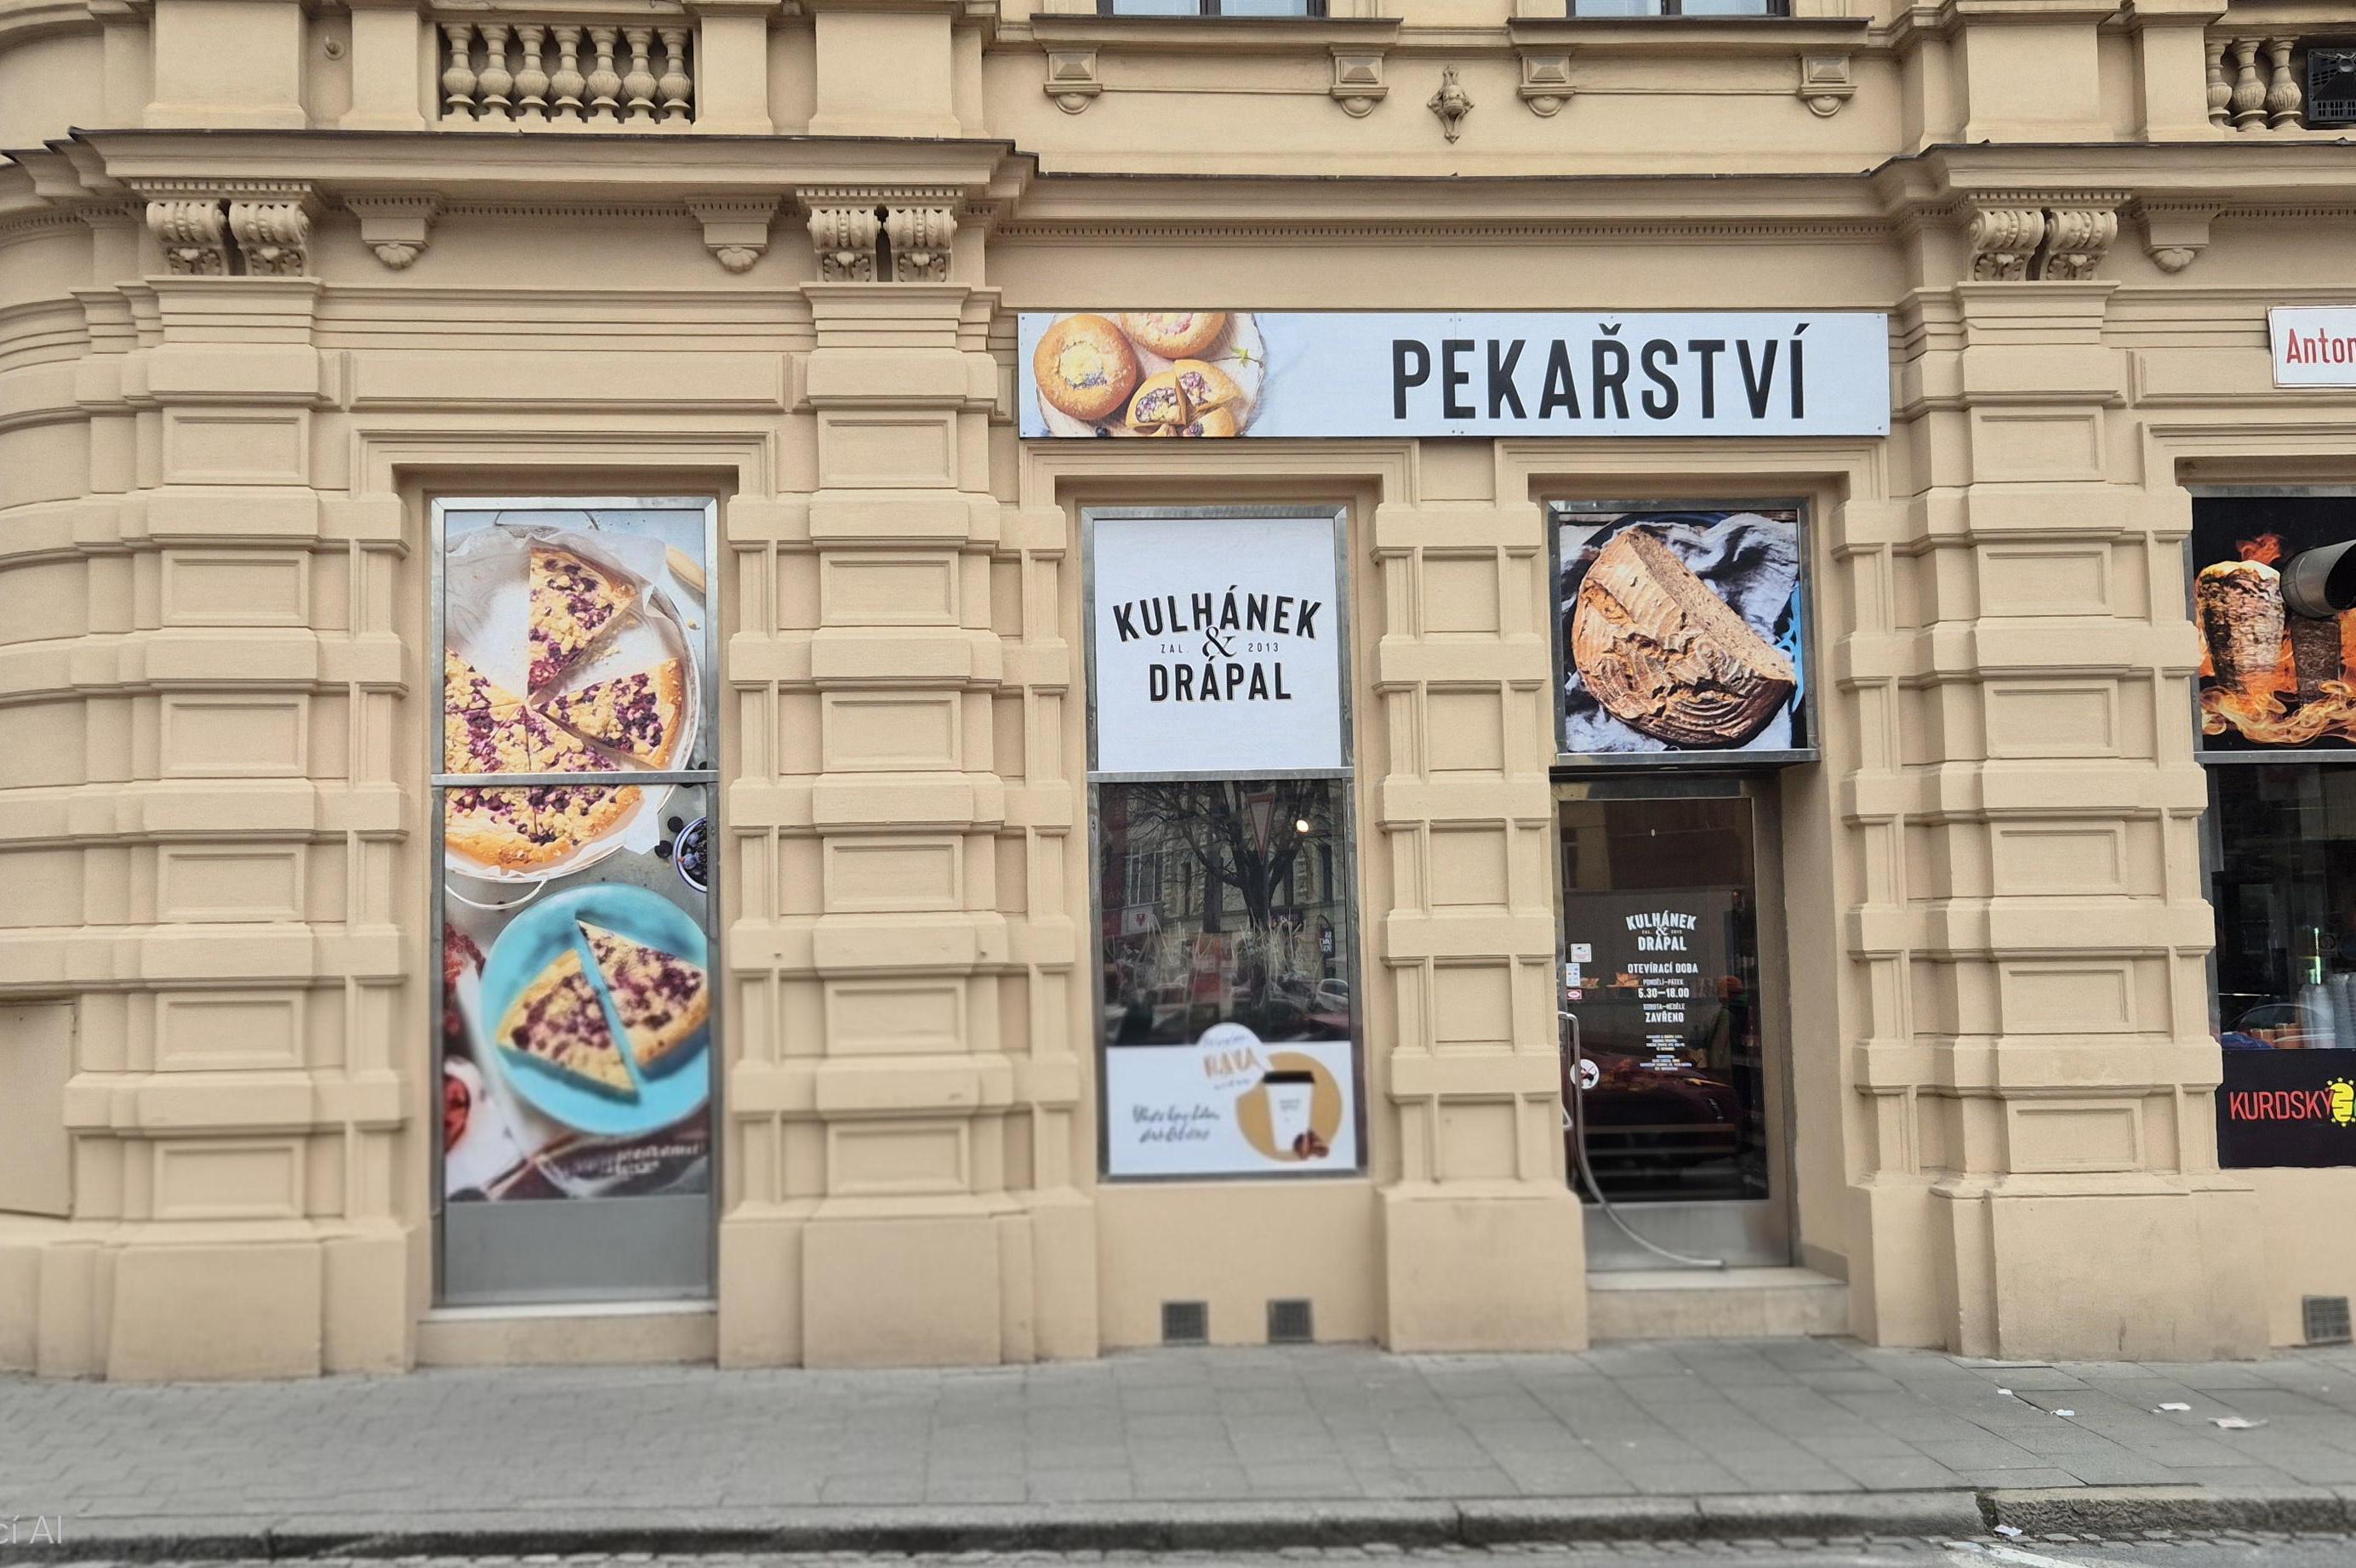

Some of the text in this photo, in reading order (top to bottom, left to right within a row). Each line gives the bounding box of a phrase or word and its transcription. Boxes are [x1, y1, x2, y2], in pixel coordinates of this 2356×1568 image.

[1392, 322, 1811, 420] PEKAŘSTVÍ
[1113, 584, 1322, 642] KULHÁNEK
[1202, 626, 1237, 658] &
[1248, 642, 1280, 653] 2013
[1149, 655, 1292, 702] DRÁPAL
[1625, 909, 1697, 932] KULHÁNEK
[1627, 961, 1698, 974] OTEVÍRACÍ DOBA
[1645, 1010, 1685, 1023] ZAVŘENO
